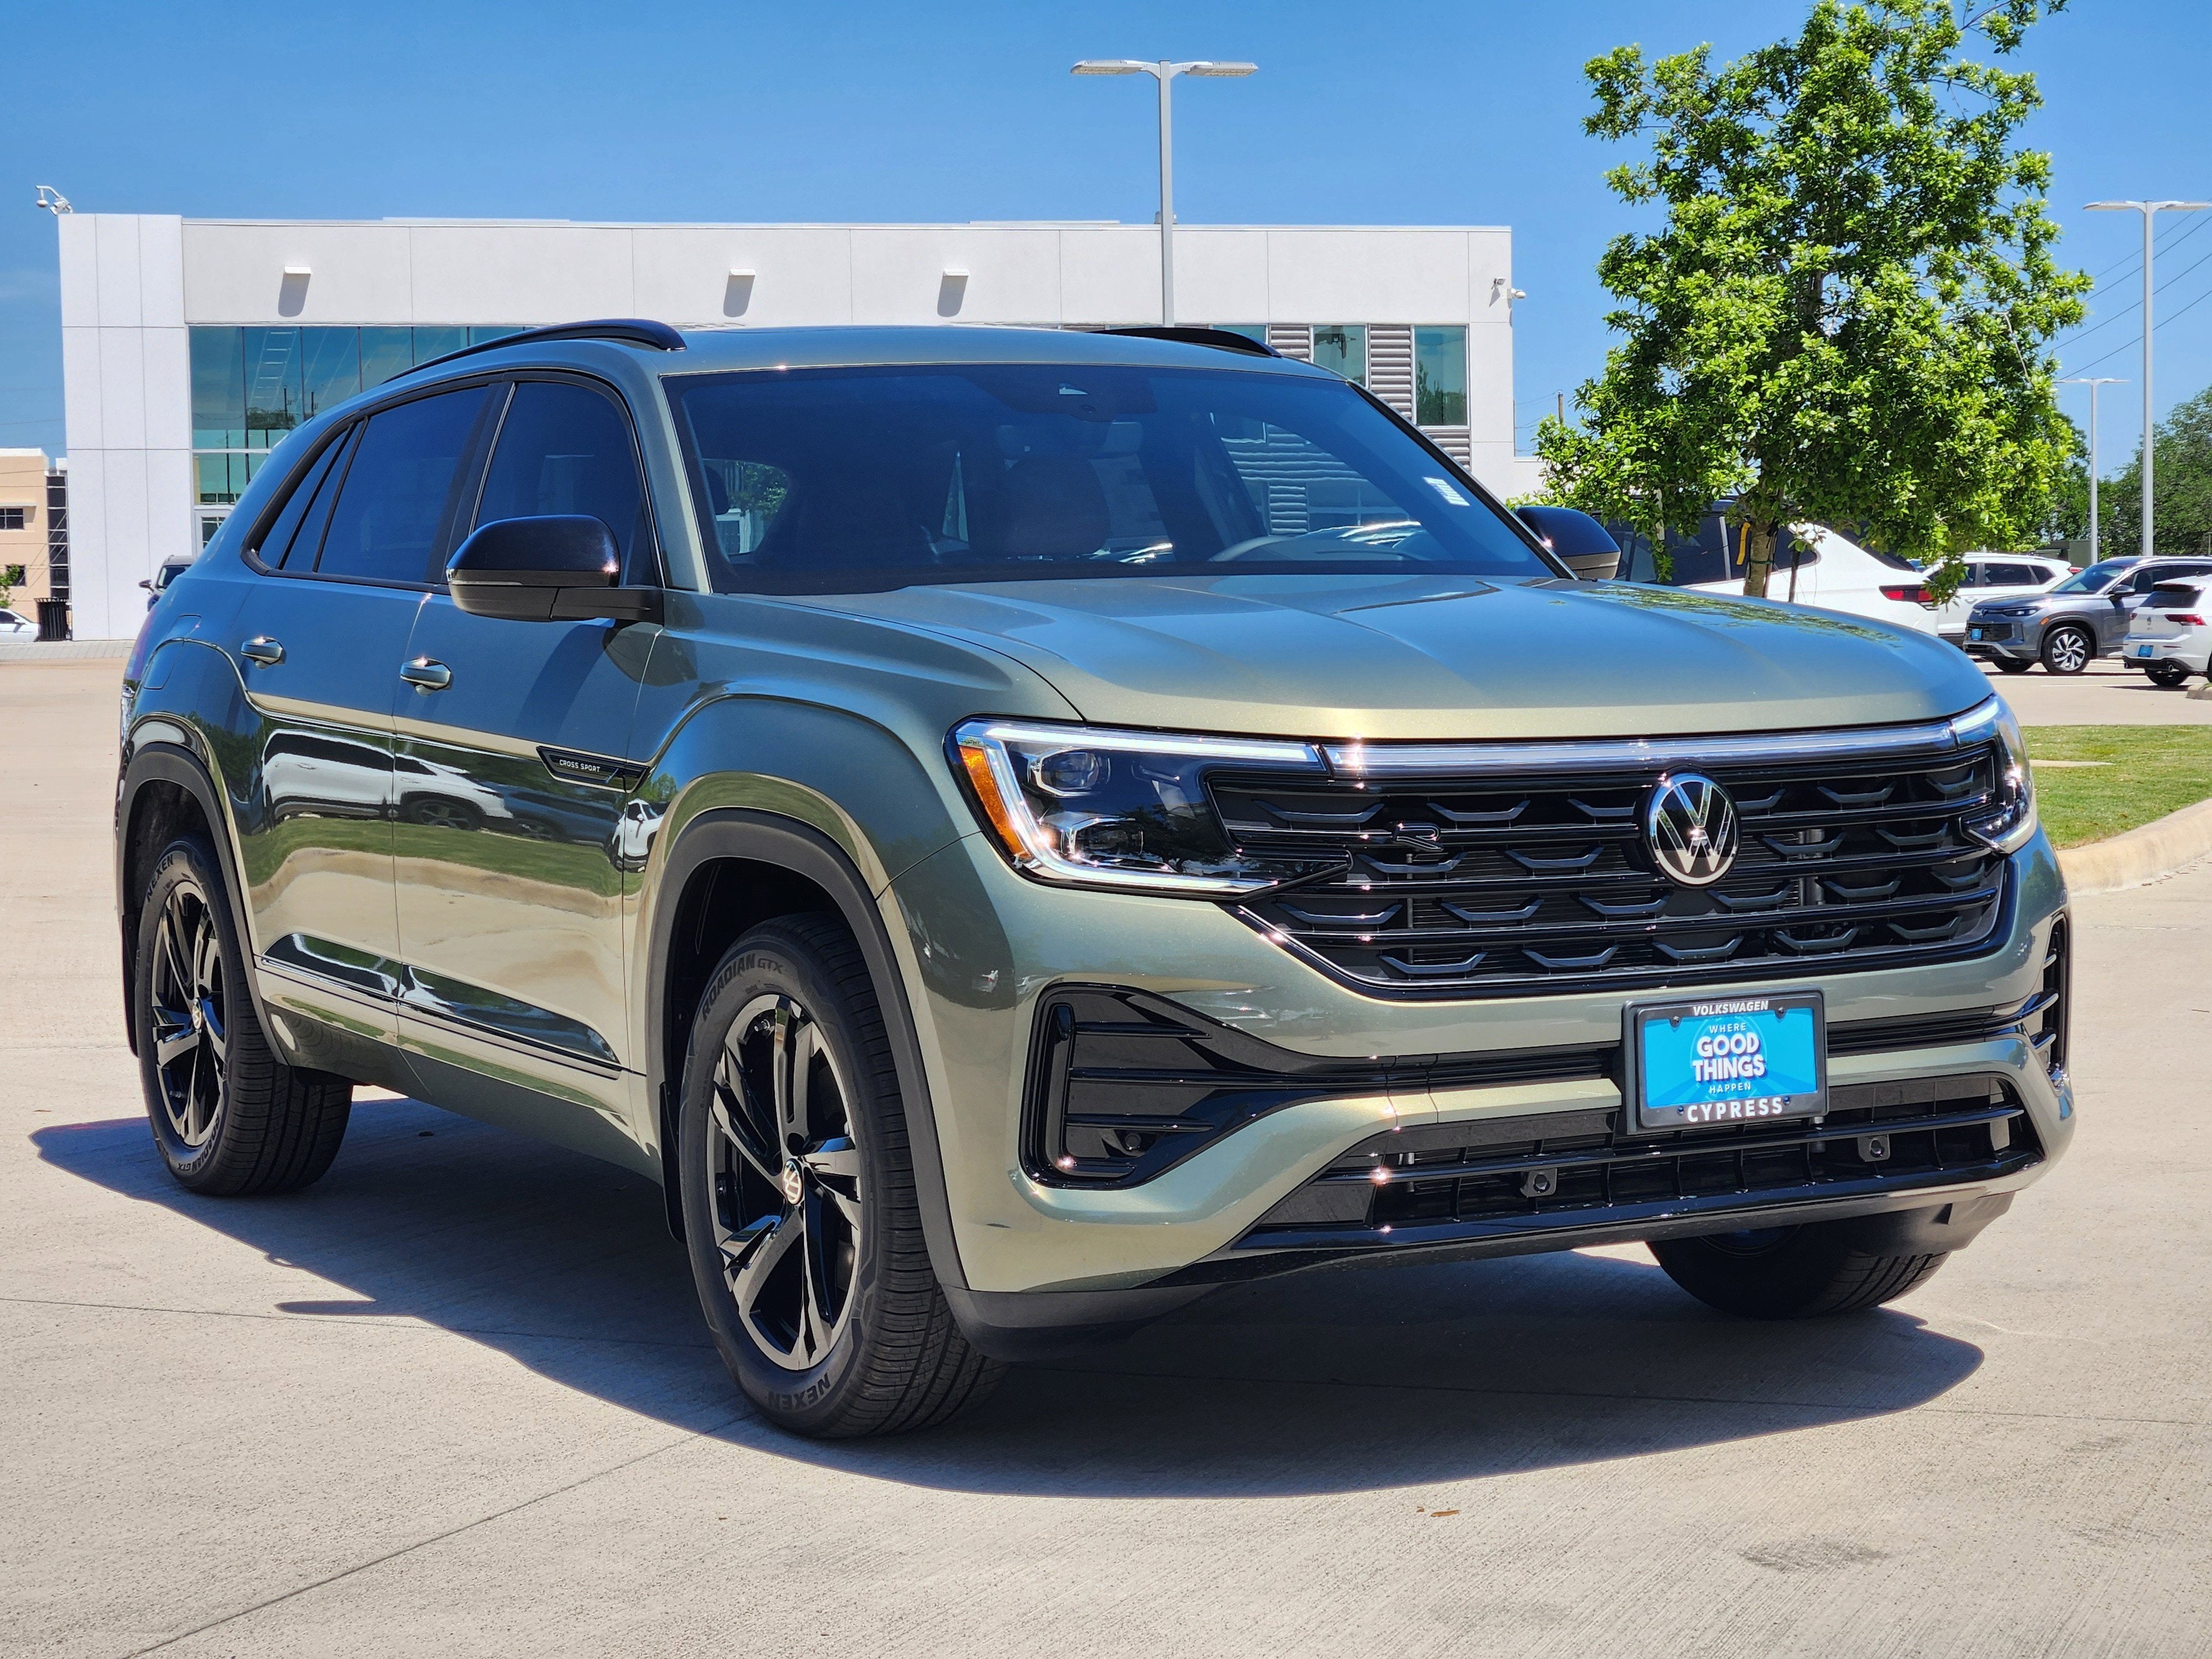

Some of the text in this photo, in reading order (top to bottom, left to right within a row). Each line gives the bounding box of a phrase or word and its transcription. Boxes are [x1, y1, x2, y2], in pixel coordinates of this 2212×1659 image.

[560, 760, 601, 773] CROSS SPORT
[147, 854, 174, 902] NEXEN
[702, 953, 784, 1022] ROADIAN GTX
[1693, 1000, 1768, 1016] VOLKSWAGEN
[1709, 1023, 1747, 1034] WHERE
[1697, 1032, 1760, 1058] GOOD
[1692, 1055, 1767, 1082] THINGS
[1709, 1082, 1751, 1094] HAPPEN
[1687, 1097, 1783, 1123] CYPRESS
[768, 1373, 831, 1410] NEXEN
